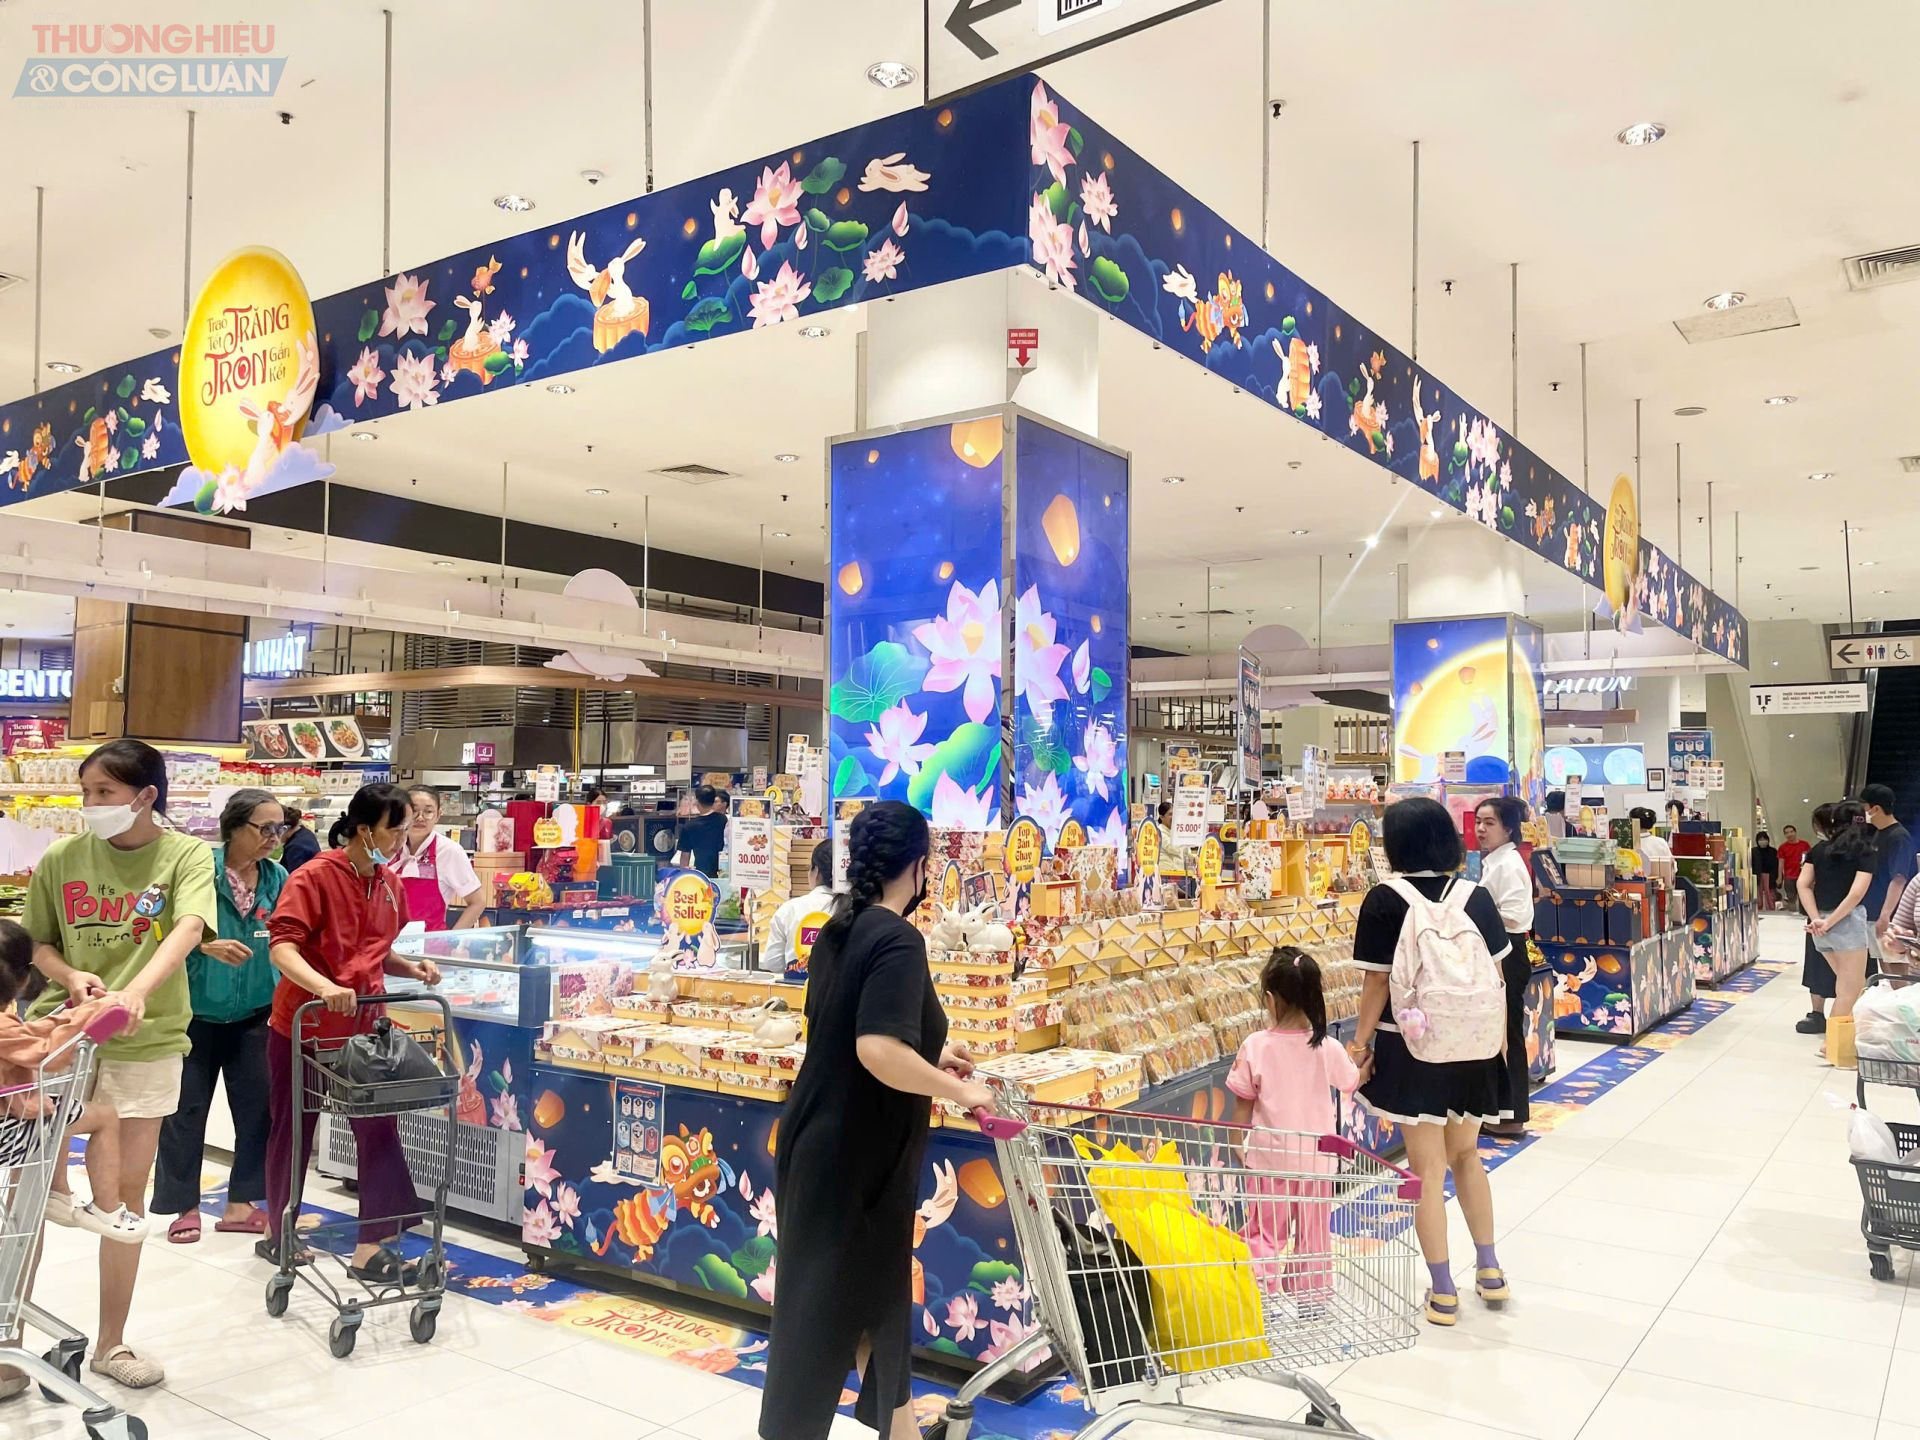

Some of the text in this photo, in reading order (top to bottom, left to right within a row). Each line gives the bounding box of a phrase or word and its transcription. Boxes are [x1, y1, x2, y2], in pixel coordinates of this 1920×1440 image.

[223, 303, 289, 354] TRĂNG
[201, 346, 267, 406] TRÒN
[255, 632, 306, 677] NHẬT
[1756, 695, 1772, 705] 1F
[1017, 826, 1030, 838] Top
[63, 881, 142, 925] PONY
[673, 890, 698, 904] Best
[673, 906, 707, 920] Seller
